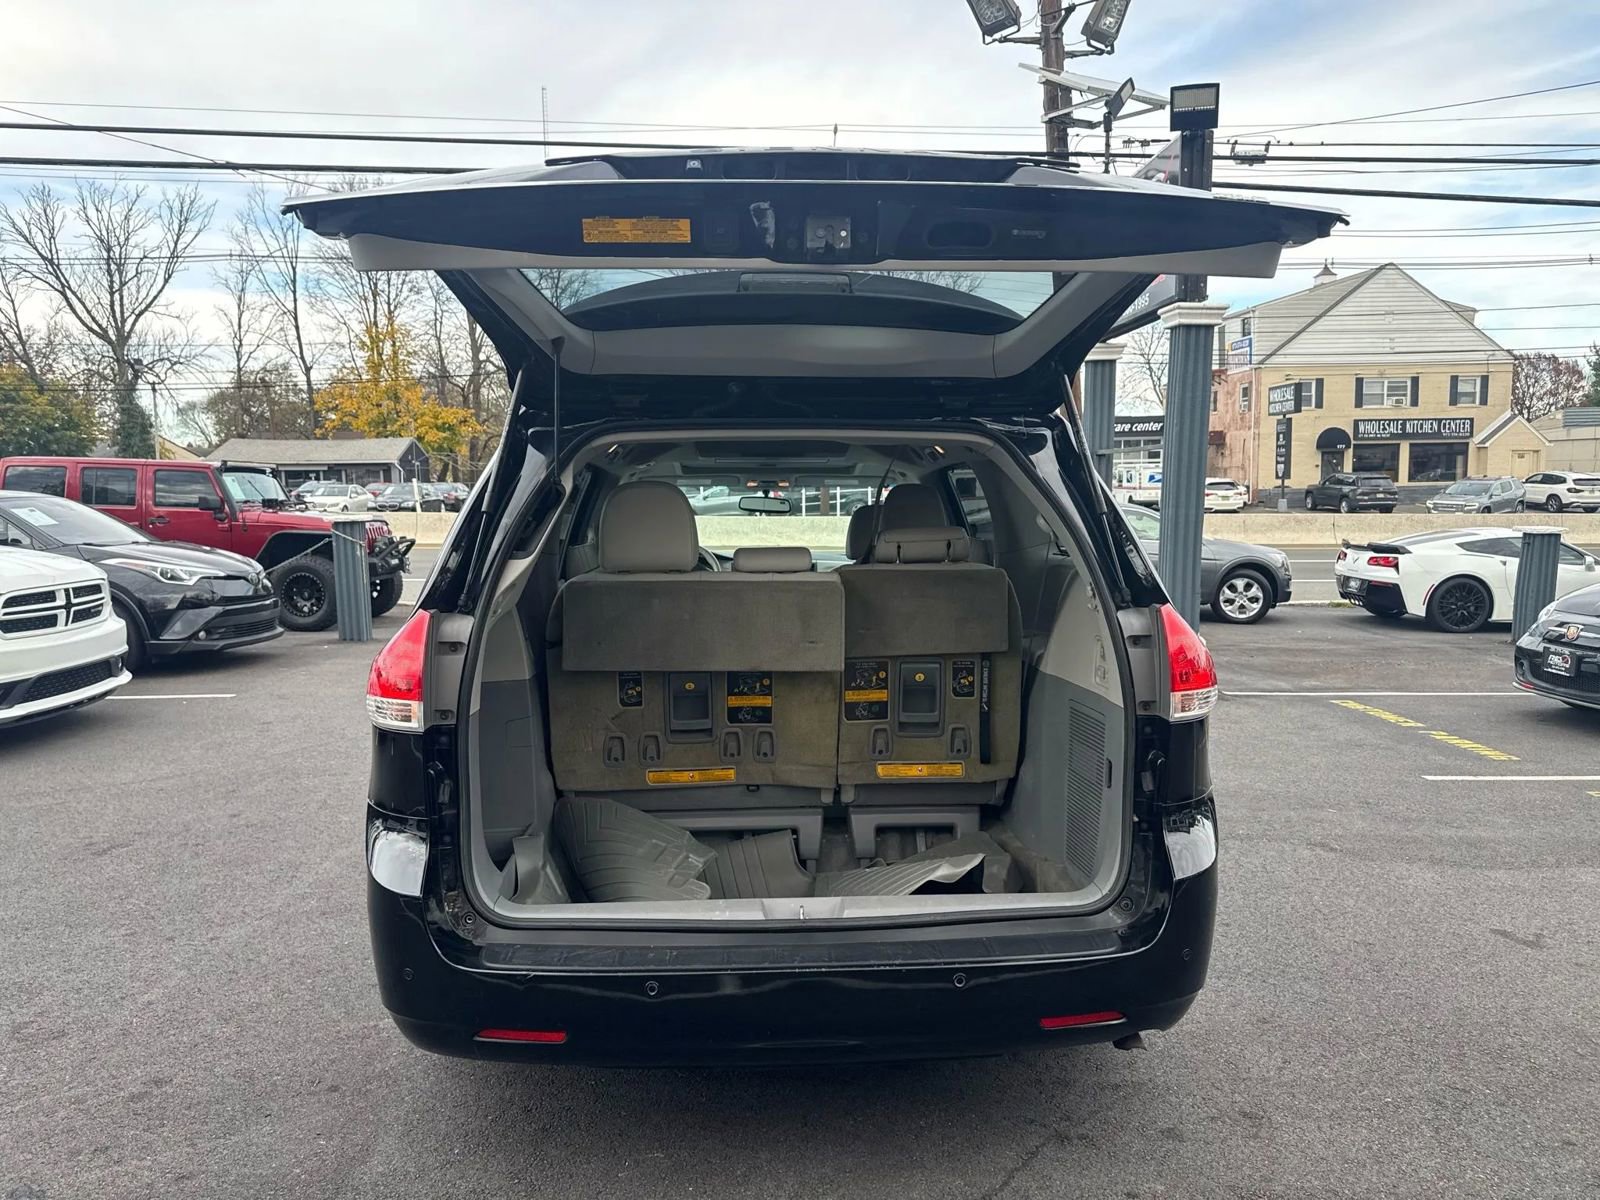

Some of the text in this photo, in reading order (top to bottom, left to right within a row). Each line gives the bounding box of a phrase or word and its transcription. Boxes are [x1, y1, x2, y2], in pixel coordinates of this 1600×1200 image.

[1269, 385, 1294, 402] WHOLESALE
[1132, 422, 1163, 431] center
[1358, 419, 1471, 434] WHOLESALE KITCHEN CENTER
